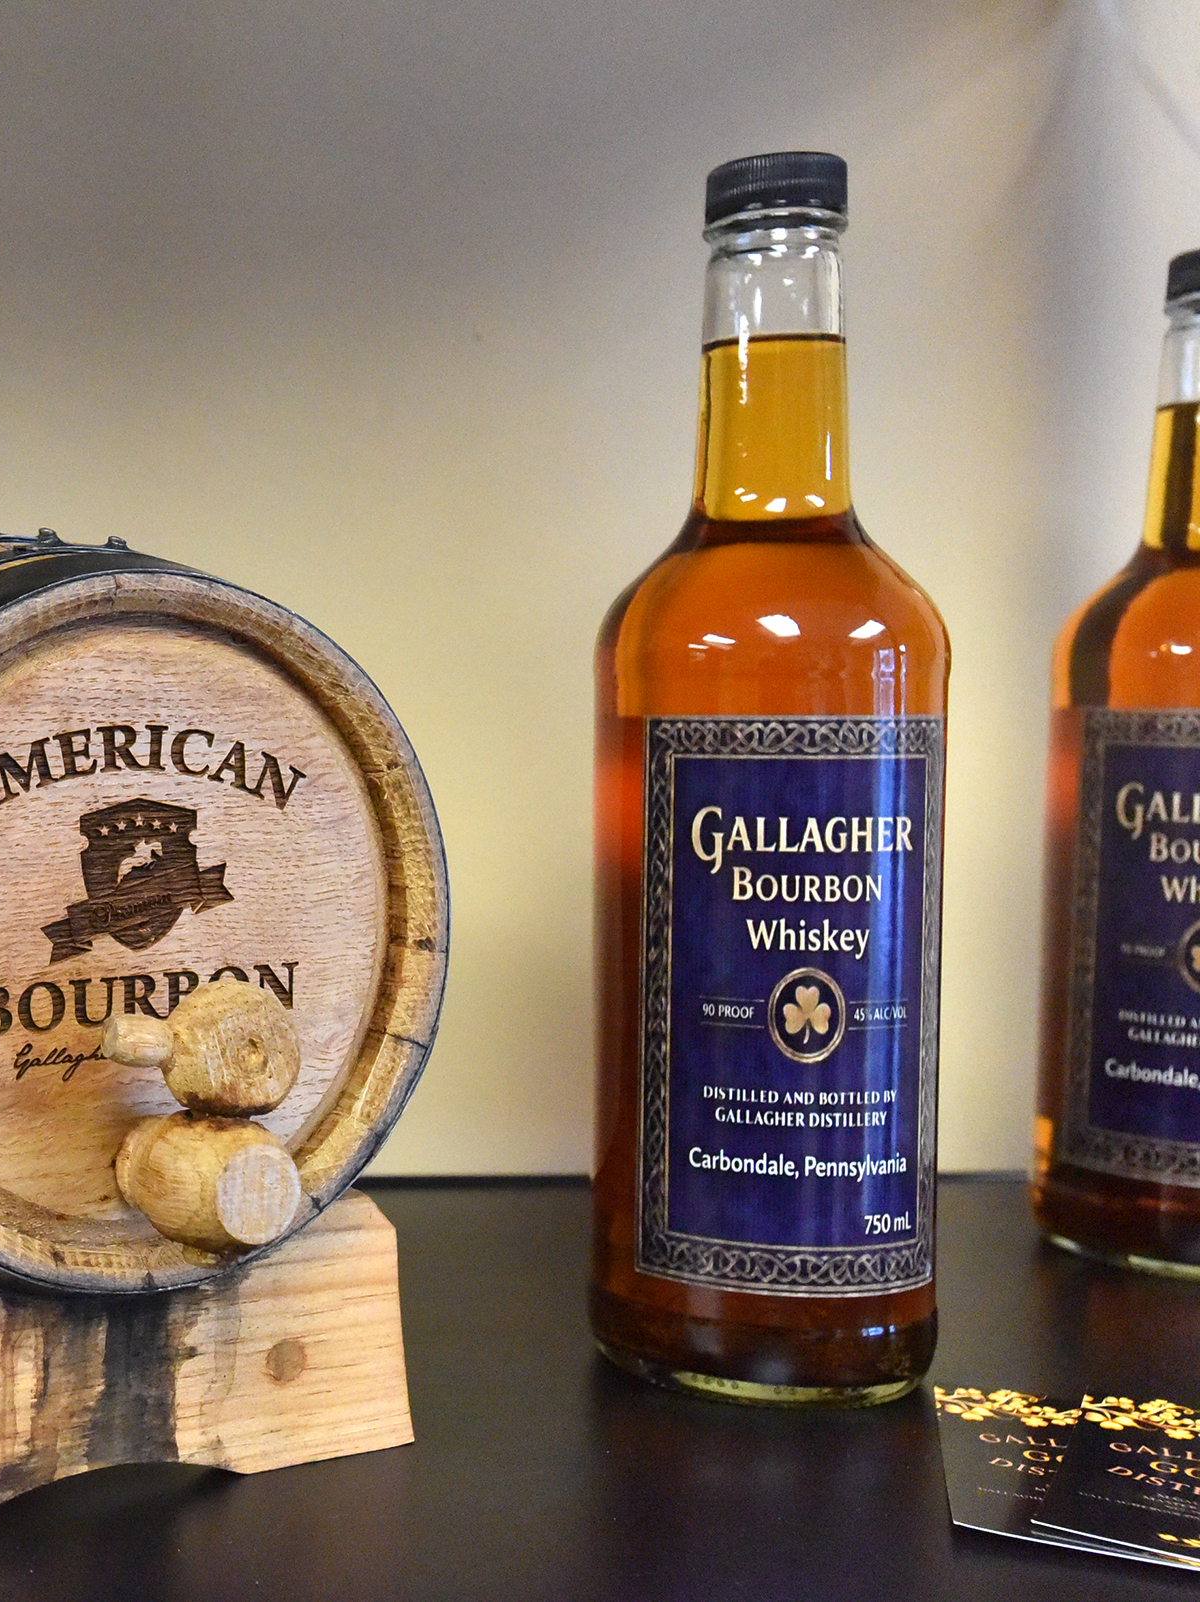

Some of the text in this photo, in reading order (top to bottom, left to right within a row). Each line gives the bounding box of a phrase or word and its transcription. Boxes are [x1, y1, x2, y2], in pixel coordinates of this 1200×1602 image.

[691, 805, 913, 875] GALLAGHER
[732, 866, 883, 903] BOURBON
[746, 918, 870, 960] Whiskey
[702, 1003, 755, 1019] 90 PROOF
[873, 1006, 907, 1022] ALC/VOL
[703, 1085, 898, 1105] DISTILLED AND BOTTLED BY
[715, 1106, 887, 1128] GALLAGHER DISTILLERY
[689, 1147, 907, 1183] Carbondale, Pennsylvania
[864, 1211, 912, 1235] 750 mL
[989, 1457, 1058, 1477] DIS
